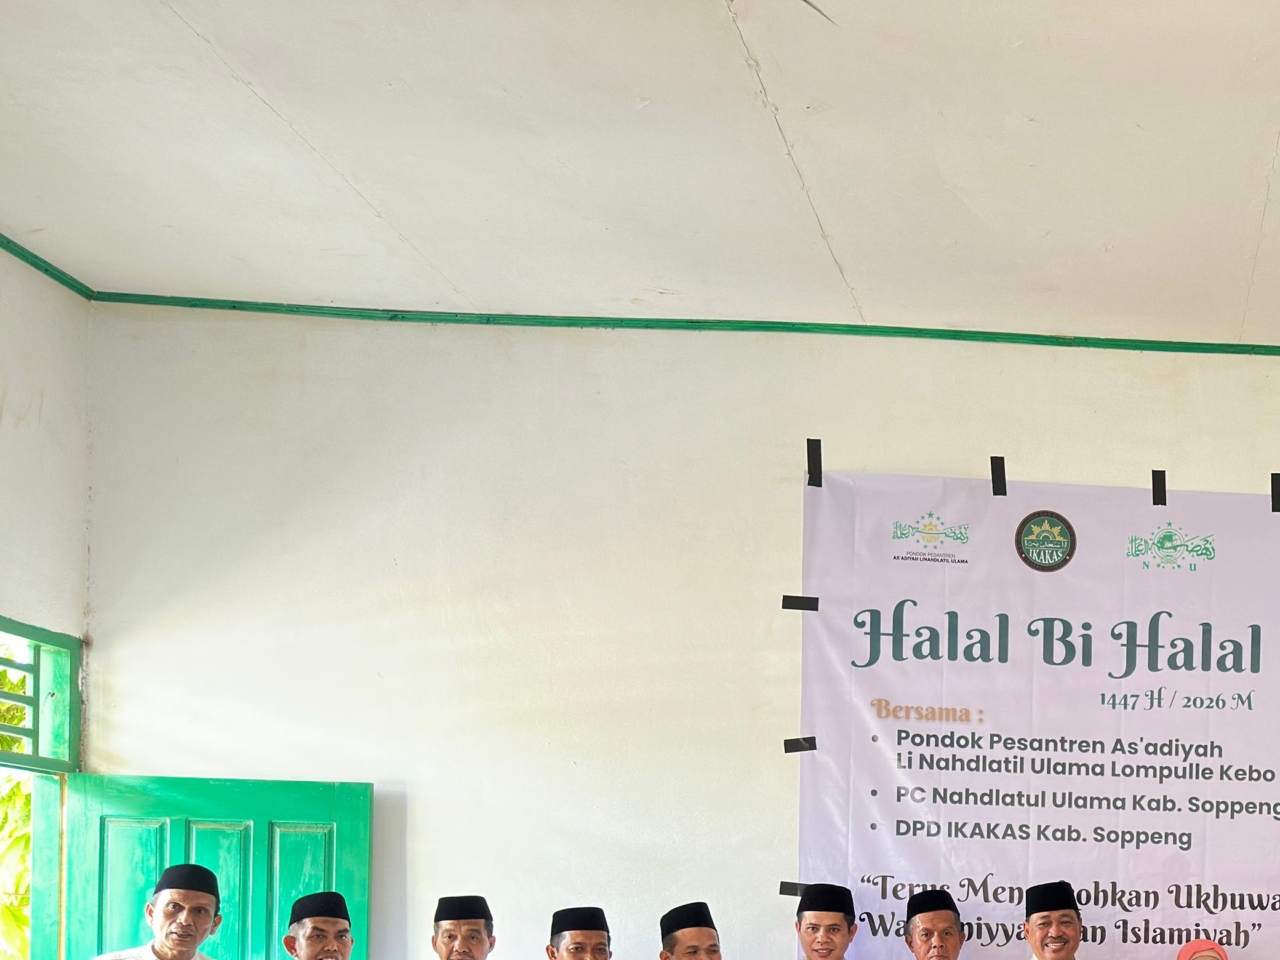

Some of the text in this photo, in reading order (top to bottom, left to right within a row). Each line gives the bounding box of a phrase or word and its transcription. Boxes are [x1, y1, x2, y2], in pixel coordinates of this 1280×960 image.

[1029, 548, 1063, 564] IKAKAS
[1142, 561, 1150, 570] N
[850, 598, 1262, 679] Halal Bi Halal
[870, 698, 971, 723] Bersama
[1099, 686, 1256, 711] 1447 H / 2026 M
[896, 729, 1223, 762] Pondok Pesantren As'adiyah
[896, 751, 1276, 784] Li Nahdlatil Ulama Lompulle Kebo
[896, 786, 926, 803] PC
[932, 787, 1046, 807] Nahdlatul
[1052, 791, 1126, 810] Ulama
[1132, 794, 1182, 812] Kab.
[895, 819, 1192, 850] DPD IKAKAS Kab. Soppeng
